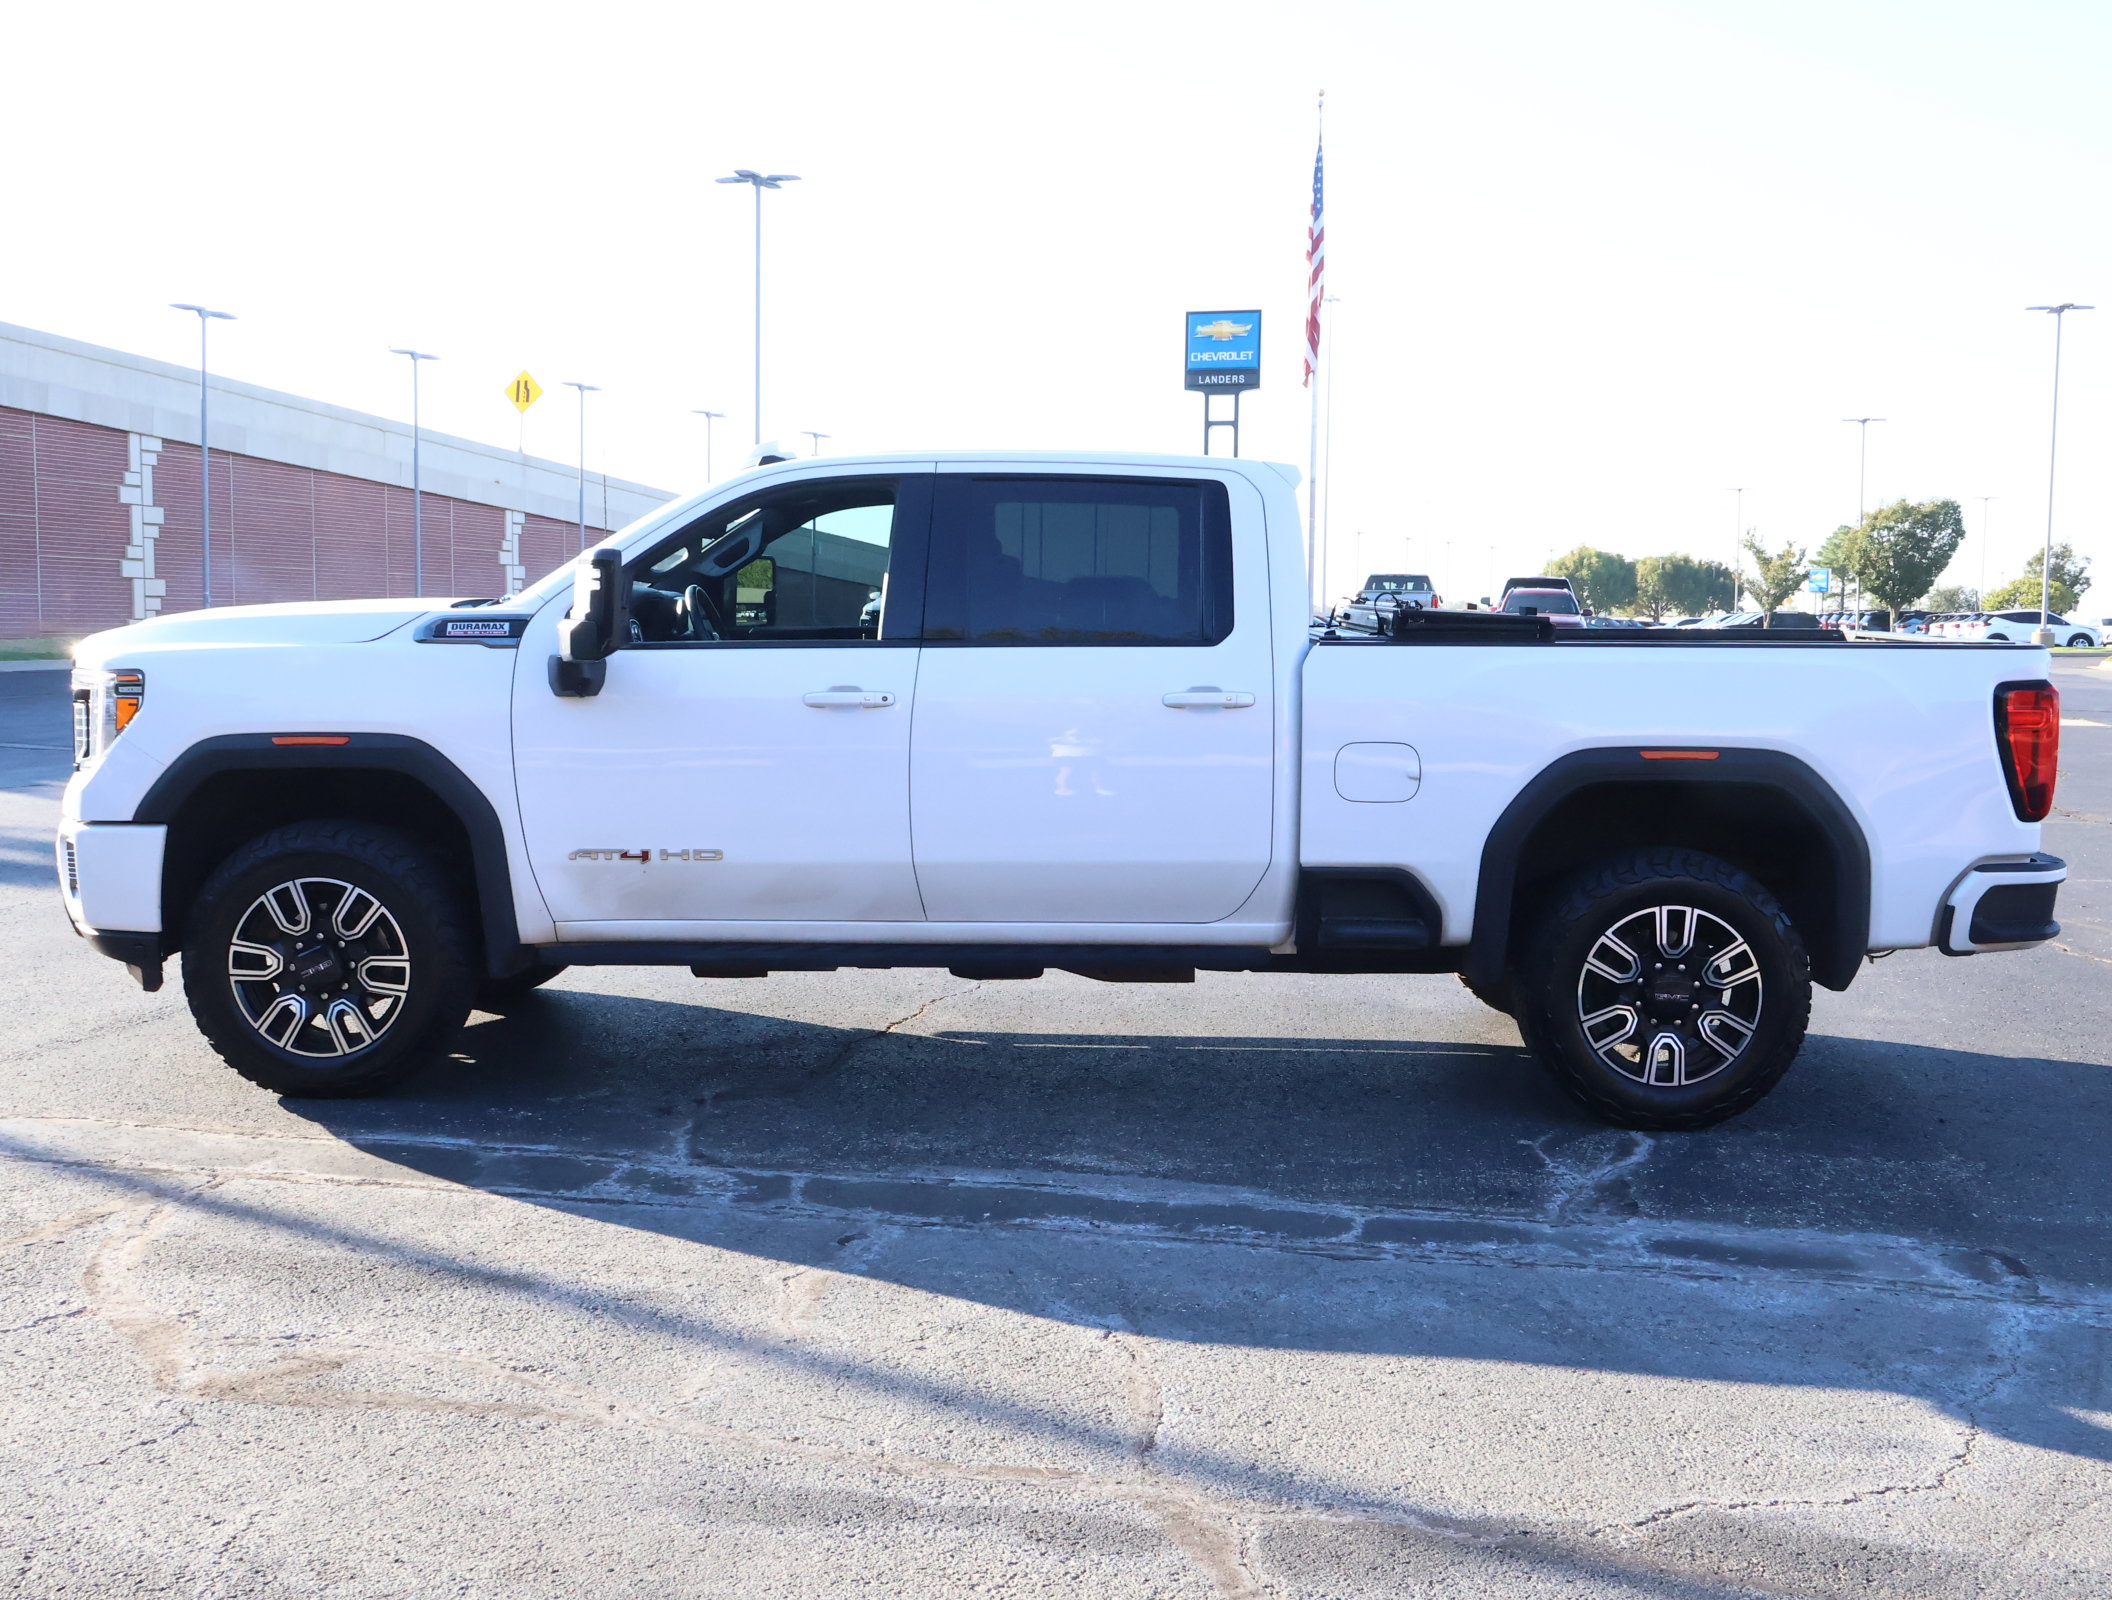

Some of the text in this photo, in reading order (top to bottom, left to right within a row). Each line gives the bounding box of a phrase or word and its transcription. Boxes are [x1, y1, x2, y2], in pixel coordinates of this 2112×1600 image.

[1190, 351, 1254, 362] CHEVROLET
[1198, 374, 1245, 384] LANDERS
[451, 623, 506, 631] DURAMAX
[568, 848, 723, 865] AT4 HD
